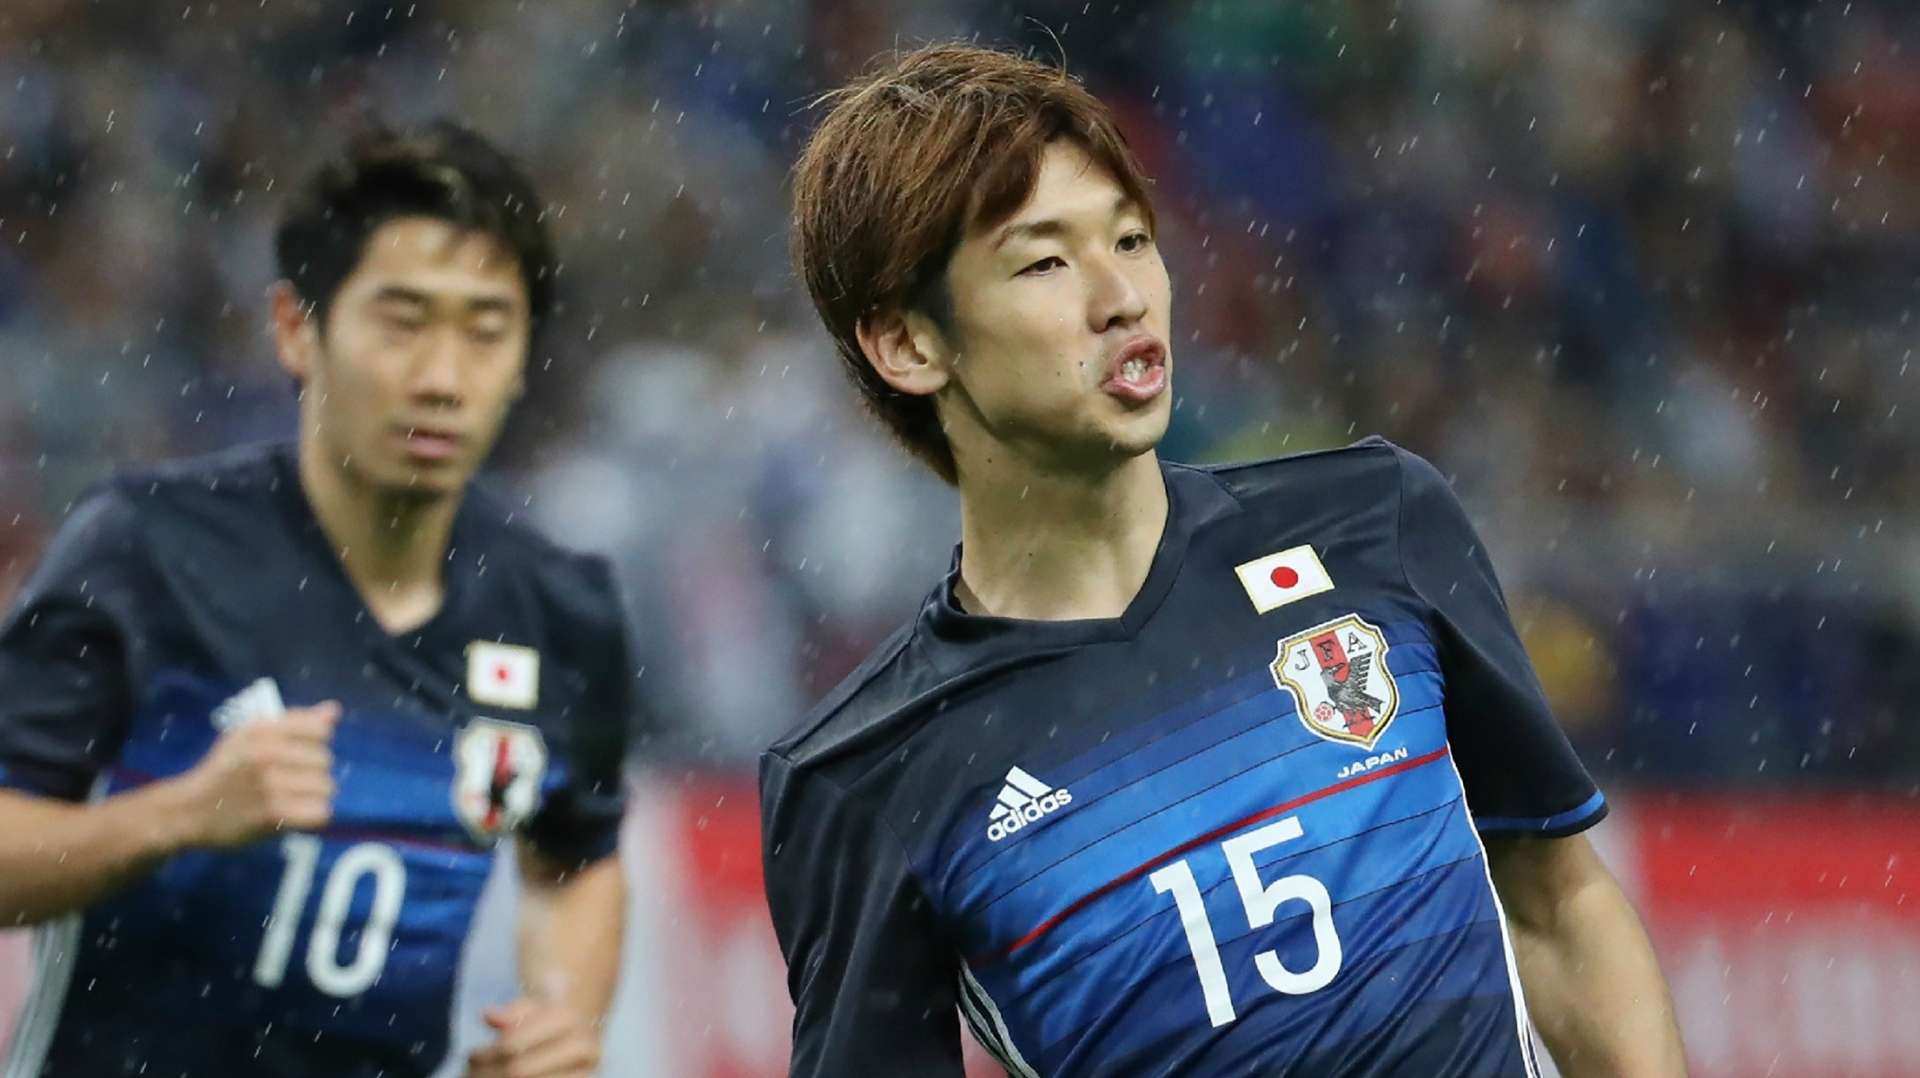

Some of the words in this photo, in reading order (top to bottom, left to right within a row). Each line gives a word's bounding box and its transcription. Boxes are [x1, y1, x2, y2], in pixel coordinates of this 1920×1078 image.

[987, 787, 1073, 842] adidas
[1337, 747, 1409, 778] JAPAN
[252, 833, 407, 998] 10
[1149, 815, 1343, 1028] 15
